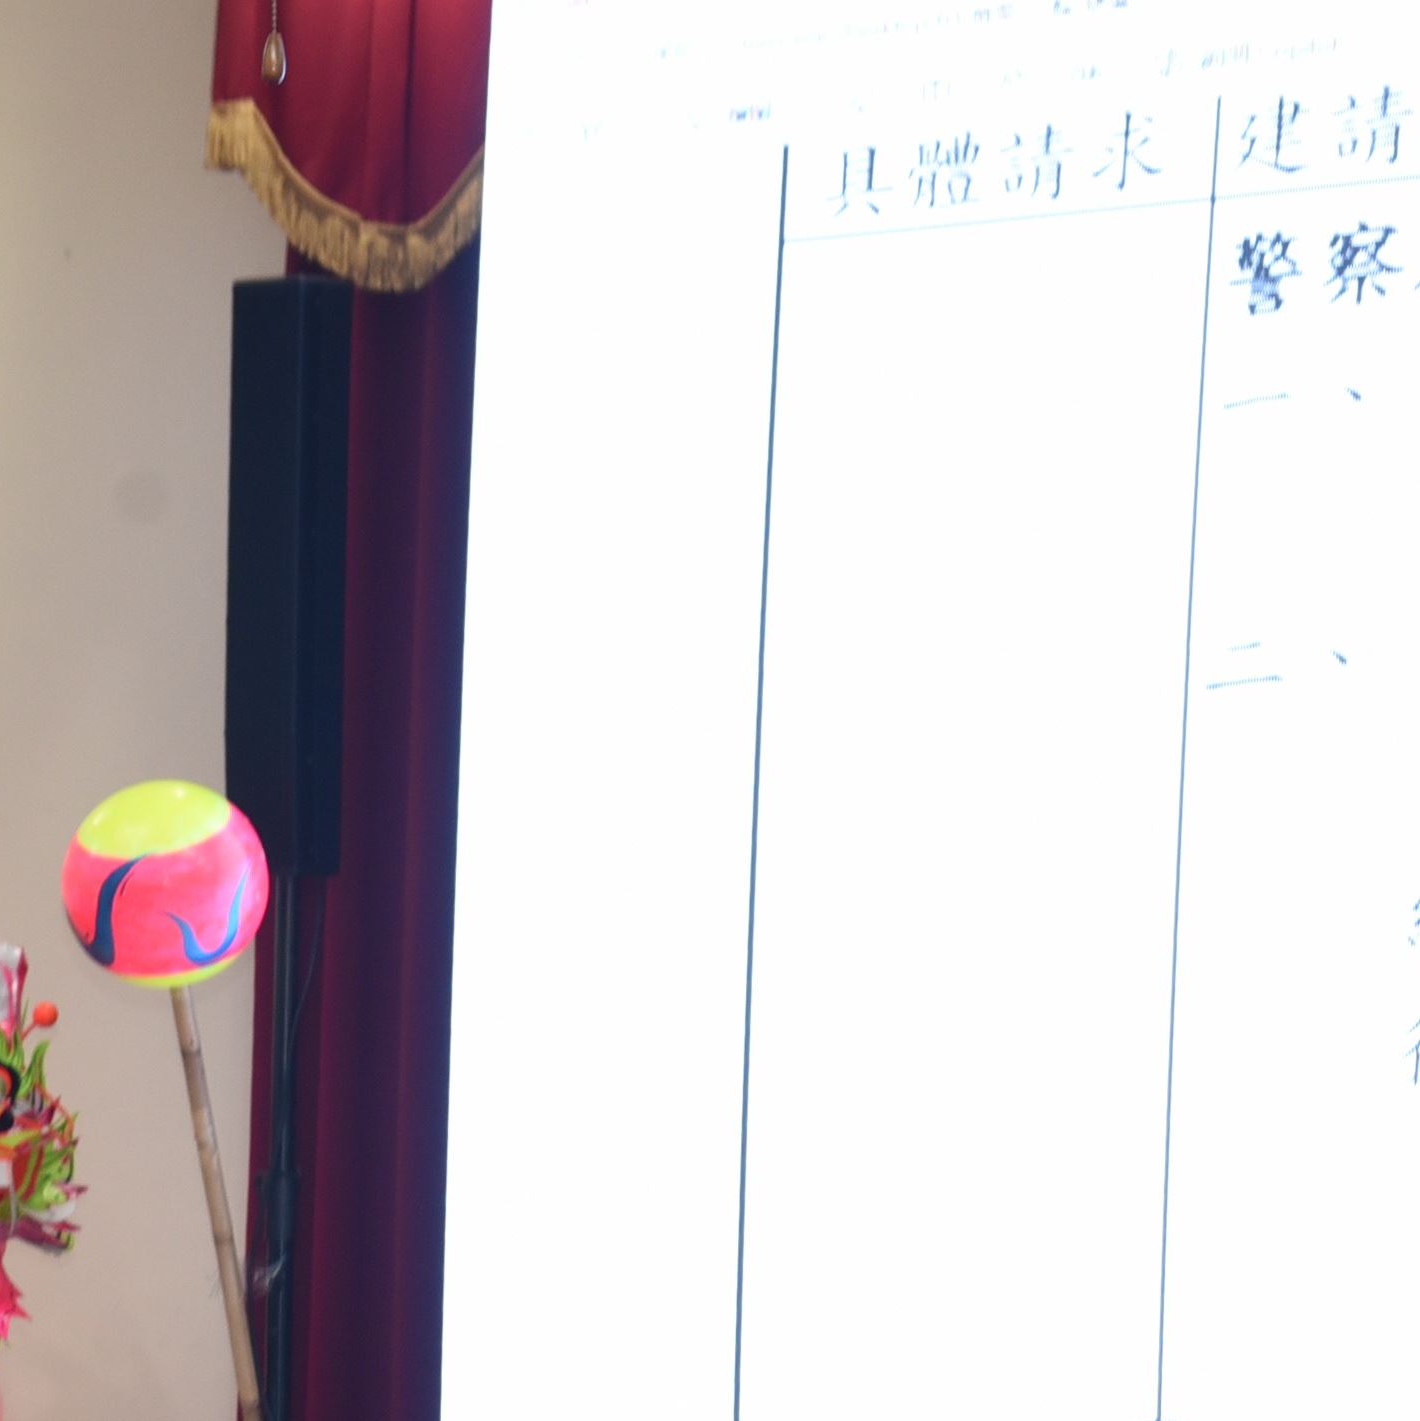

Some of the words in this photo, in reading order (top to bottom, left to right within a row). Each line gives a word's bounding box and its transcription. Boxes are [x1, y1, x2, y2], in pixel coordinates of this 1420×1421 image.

[826, 109, 1163, 218] 具體請求
[1237, 84, 1416, 174] 建請
[1229, 222, 1420, 316] 警察
